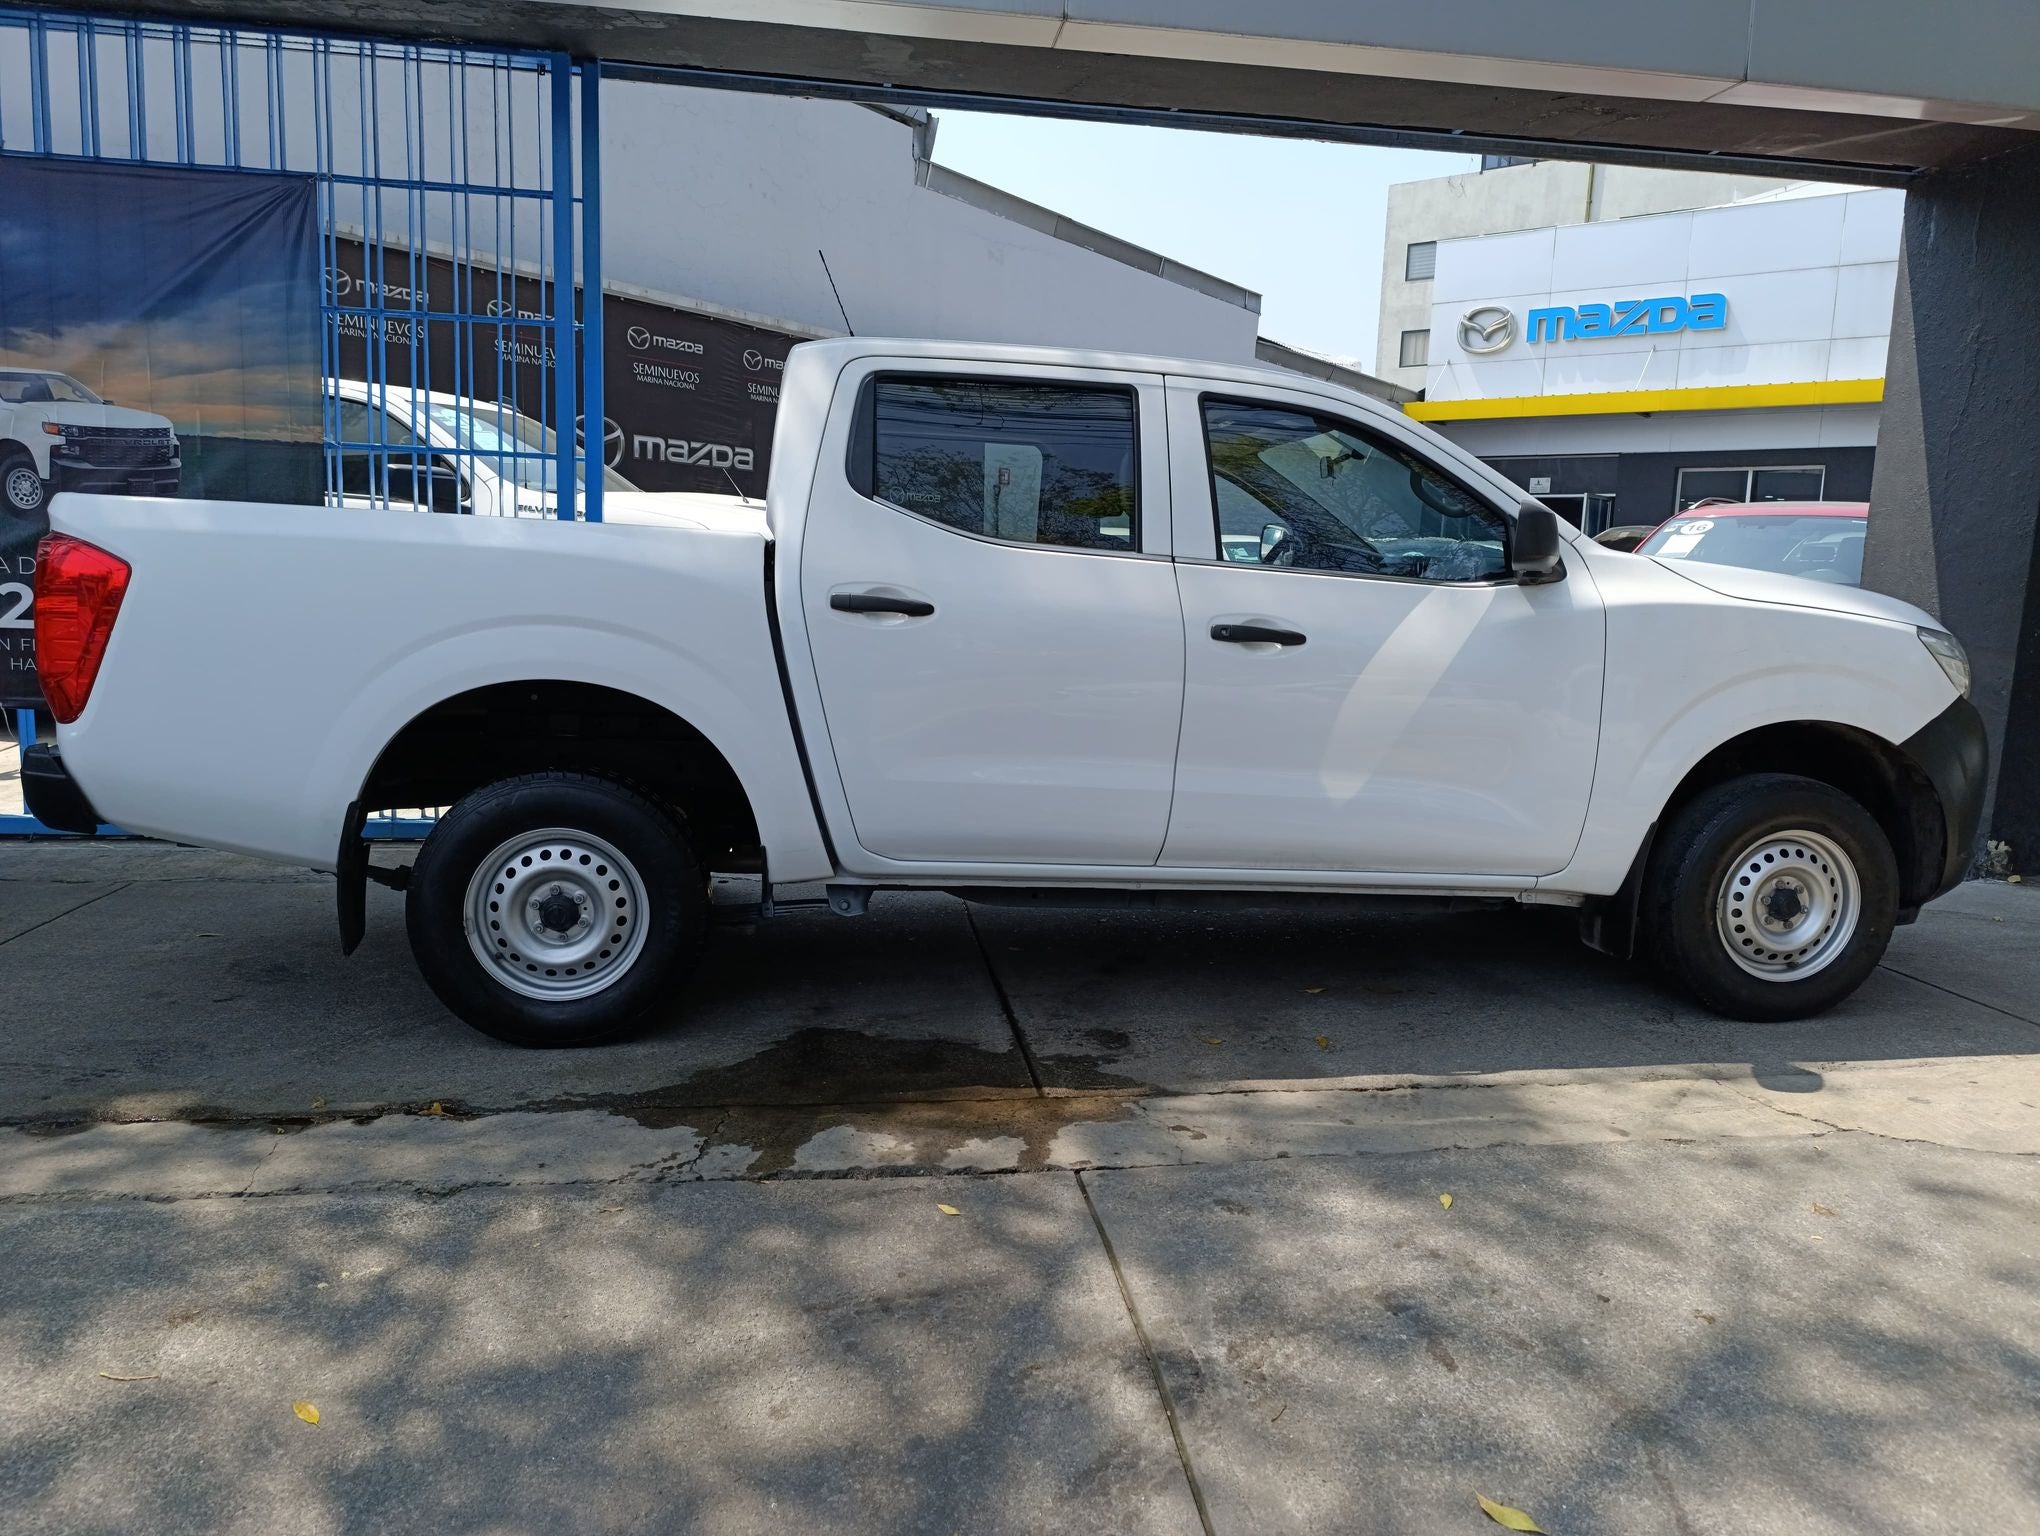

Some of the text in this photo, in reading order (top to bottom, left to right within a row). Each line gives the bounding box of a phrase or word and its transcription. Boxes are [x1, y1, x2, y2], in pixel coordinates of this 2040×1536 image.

[1527, 293, 1727, 343] mazda
[494, 339, 556, 360] SEMINUEV
[653, 335, 703, 354] mazda
[633, 362, 700, 384] SEMINUEVOS
[764, 358, 784, 370] ma
[636, 375, 696, 391] MARINA NACIONAL
[747, 383, 780, 398] SEMINU
[633, 434, 754, 471] mazda
[1688, 523, 1708, 532] 16
